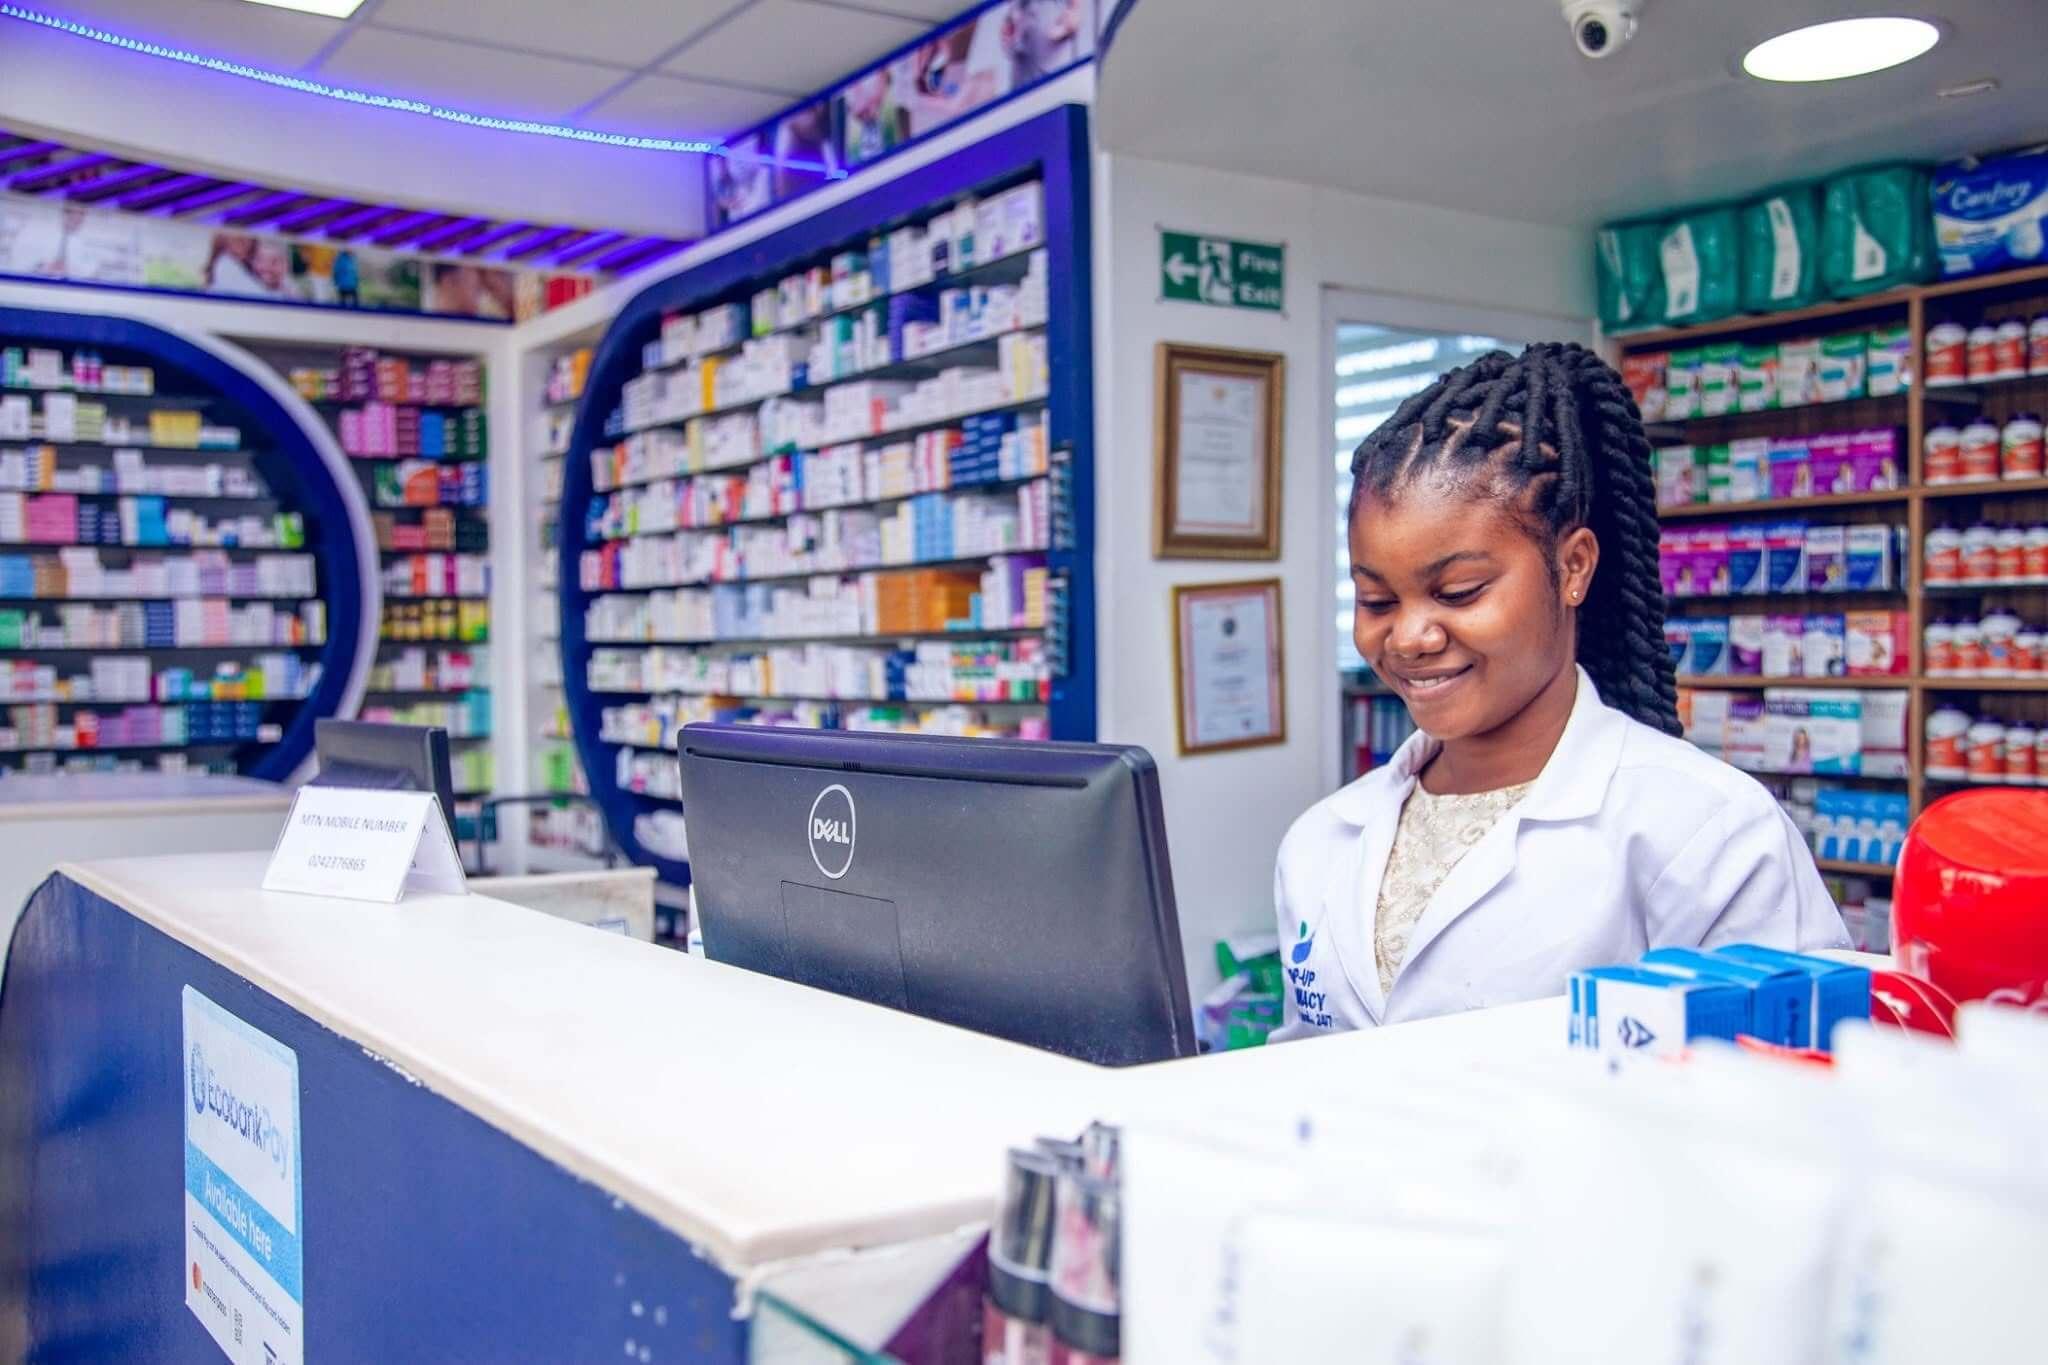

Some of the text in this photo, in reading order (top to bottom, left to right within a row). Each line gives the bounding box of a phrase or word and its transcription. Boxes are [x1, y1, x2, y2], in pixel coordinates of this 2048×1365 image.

[1239, 251, 1279, 274] Fire
[1239, 282, 1280, 304] Exit
[302, 813, 408, 833] MTN MOBILE NUMBER
[814, 818, 850, 844] DELL
[205, 1171, 248, 1237] Available
[248, 1209, 272, 1261] here
